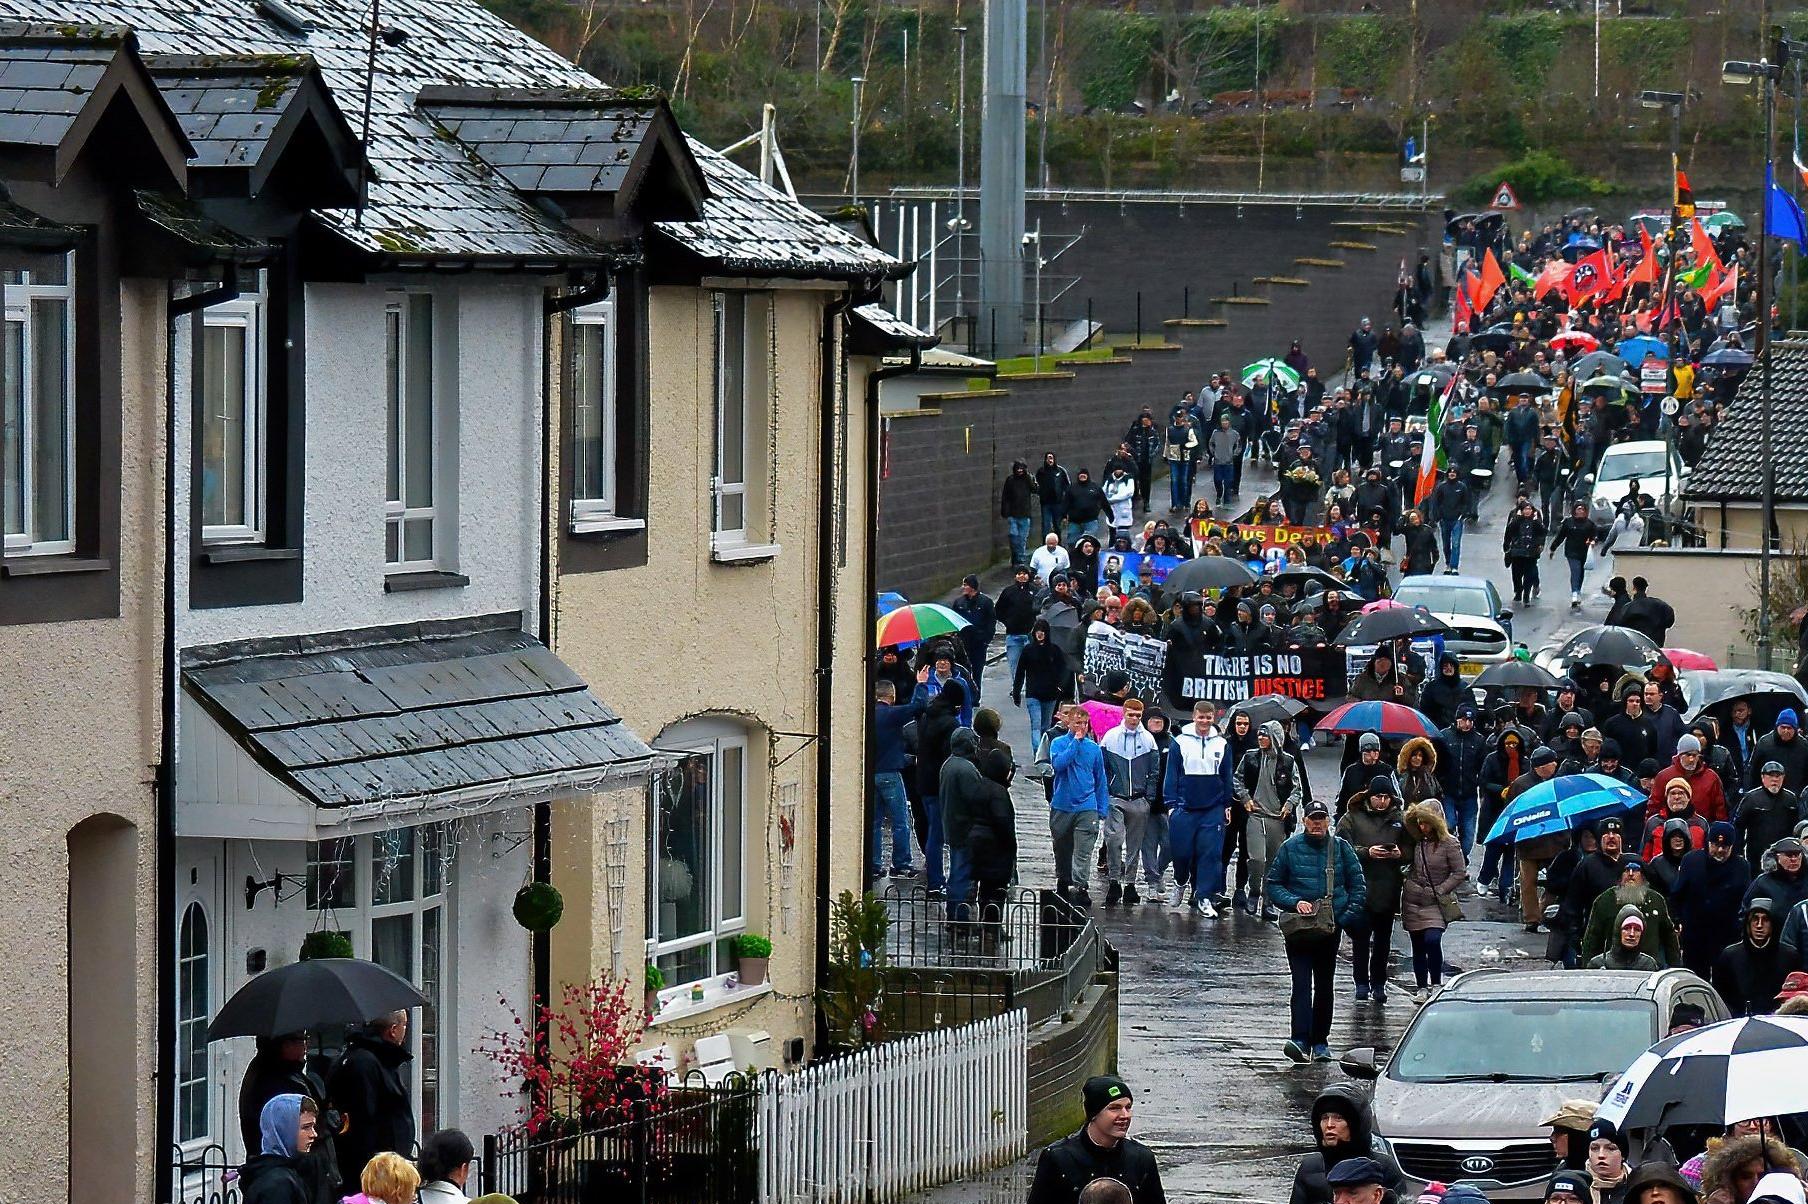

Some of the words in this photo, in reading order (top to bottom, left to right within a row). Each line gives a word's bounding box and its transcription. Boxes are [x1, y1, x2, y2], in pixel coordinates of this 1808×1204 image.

[1254, 655, 1273, 676] IS
[1277, 654, 1303, 675] NO
[1181, 677, 1249, 701] BRITISH
[1253, 677, 1325, 699] JUSTICE
[1466, 1160, 1488, 1170] KIA
